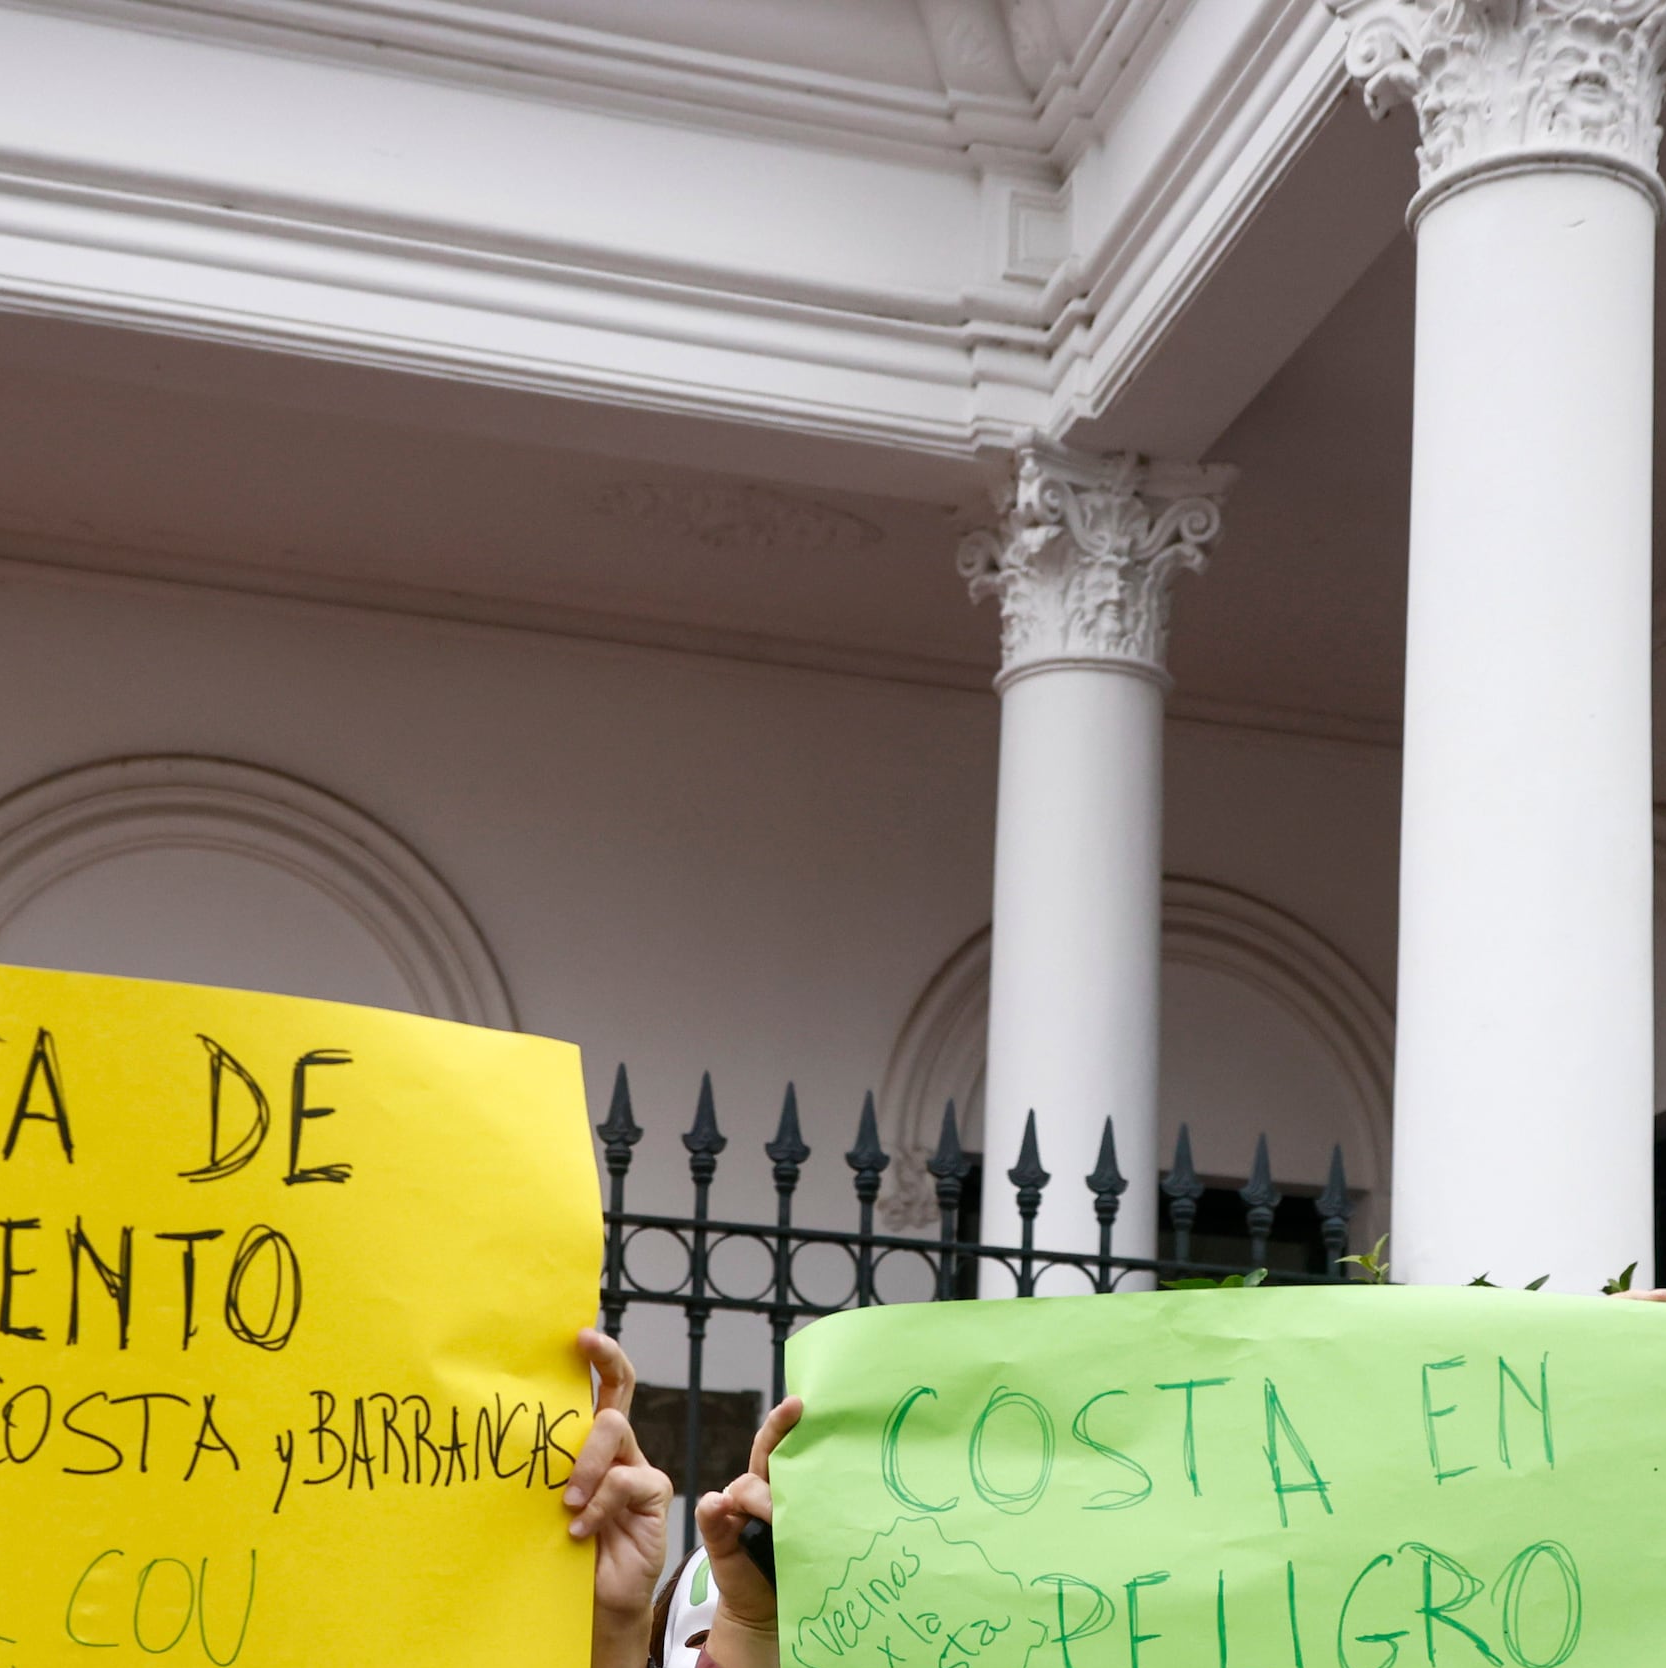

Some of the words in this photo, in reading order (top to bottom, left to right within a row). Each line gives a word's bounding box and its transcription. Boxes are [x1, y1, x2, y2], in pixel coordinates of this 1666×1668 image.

[177, 1033, 353, 1187] DE
[302, 1390, 579, 1490] BARRANCAS
[883, 1376, 1333, 1529] COSTA
[1422, 1352, 1554, 1485] EN
[66, 1549, 256, 1667] COU
[898, 1613, 941, 1644] la
